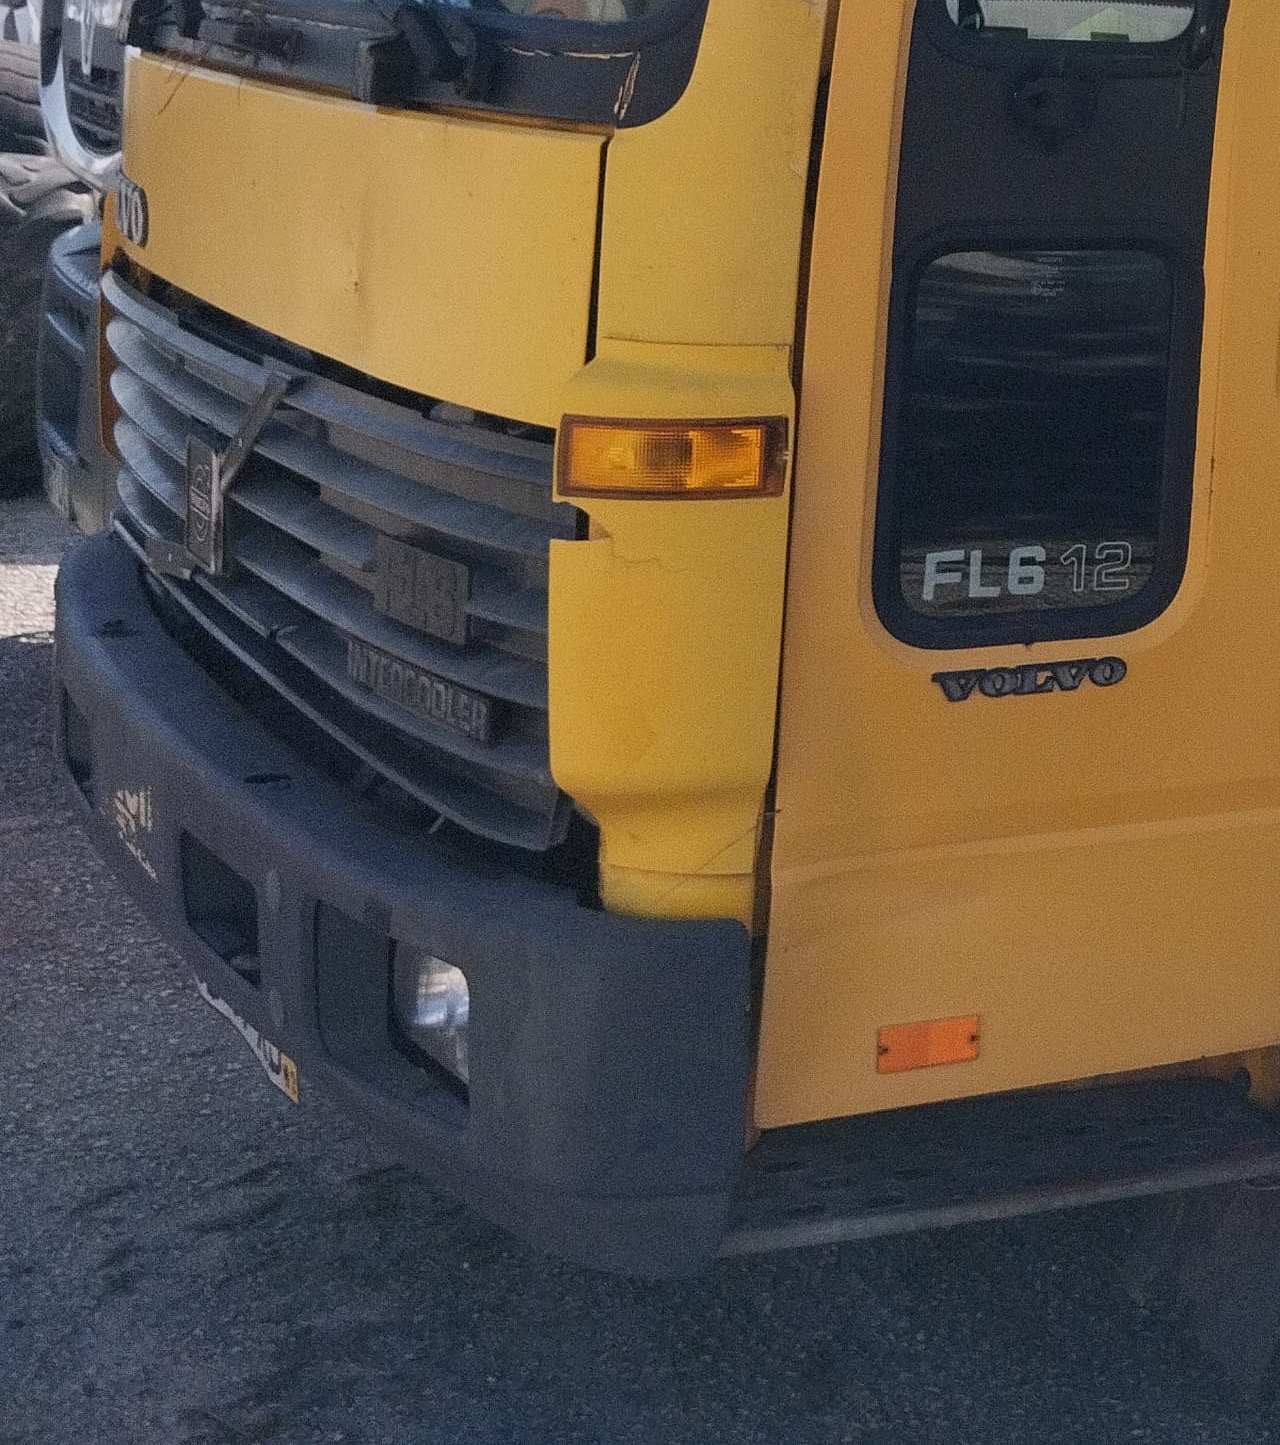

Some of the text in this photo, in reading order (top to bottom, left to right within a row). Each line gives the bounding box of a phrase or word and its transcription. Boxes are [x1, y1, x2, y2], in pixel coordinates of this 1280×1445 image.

[922, 542, 1132, 601] FL6 12
[930, 656, 1128, 703] VOLVO
